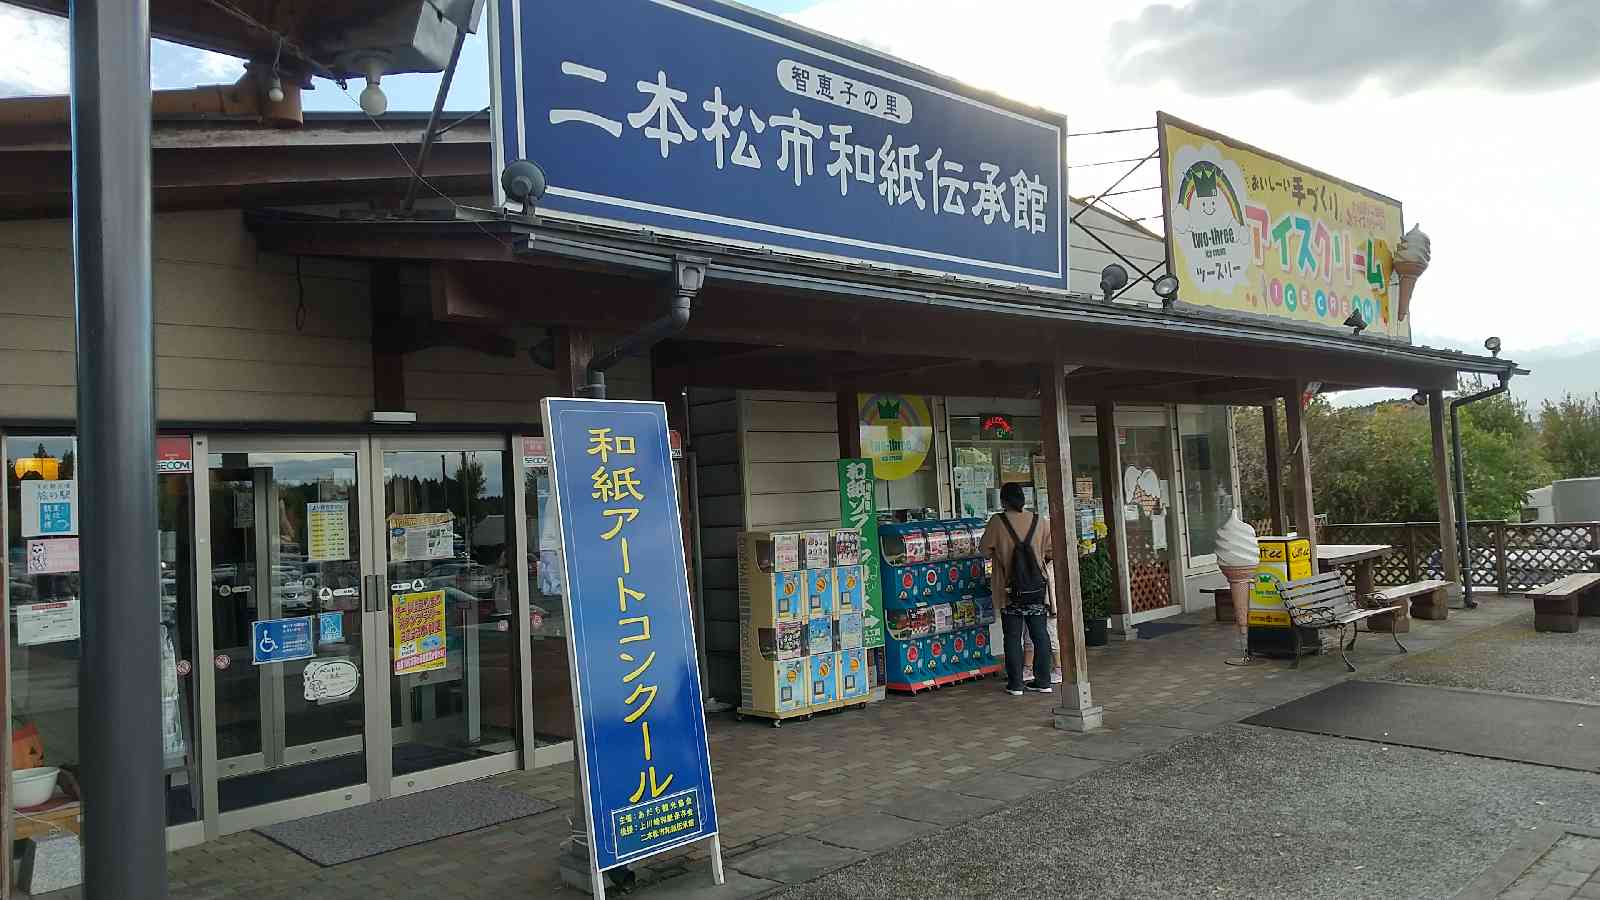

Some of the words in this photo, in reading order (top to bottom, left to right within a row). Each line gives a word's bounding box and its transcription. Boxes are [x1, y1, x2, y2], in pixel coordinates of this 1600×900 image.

[791, 66, 901, 119] 智恵子の里
[549, 61, 1048, 234] 二本松市和紙伝承館
[1192, 227, 1235, 249] two-three
[1245, 205, 1384, 290] アイスクリーム
[1196, 261, 1241, 283] ツースリー
[157, 461, 191, 470] ECOM
[587, 427, 674, 803] 和紙アートコンクール
